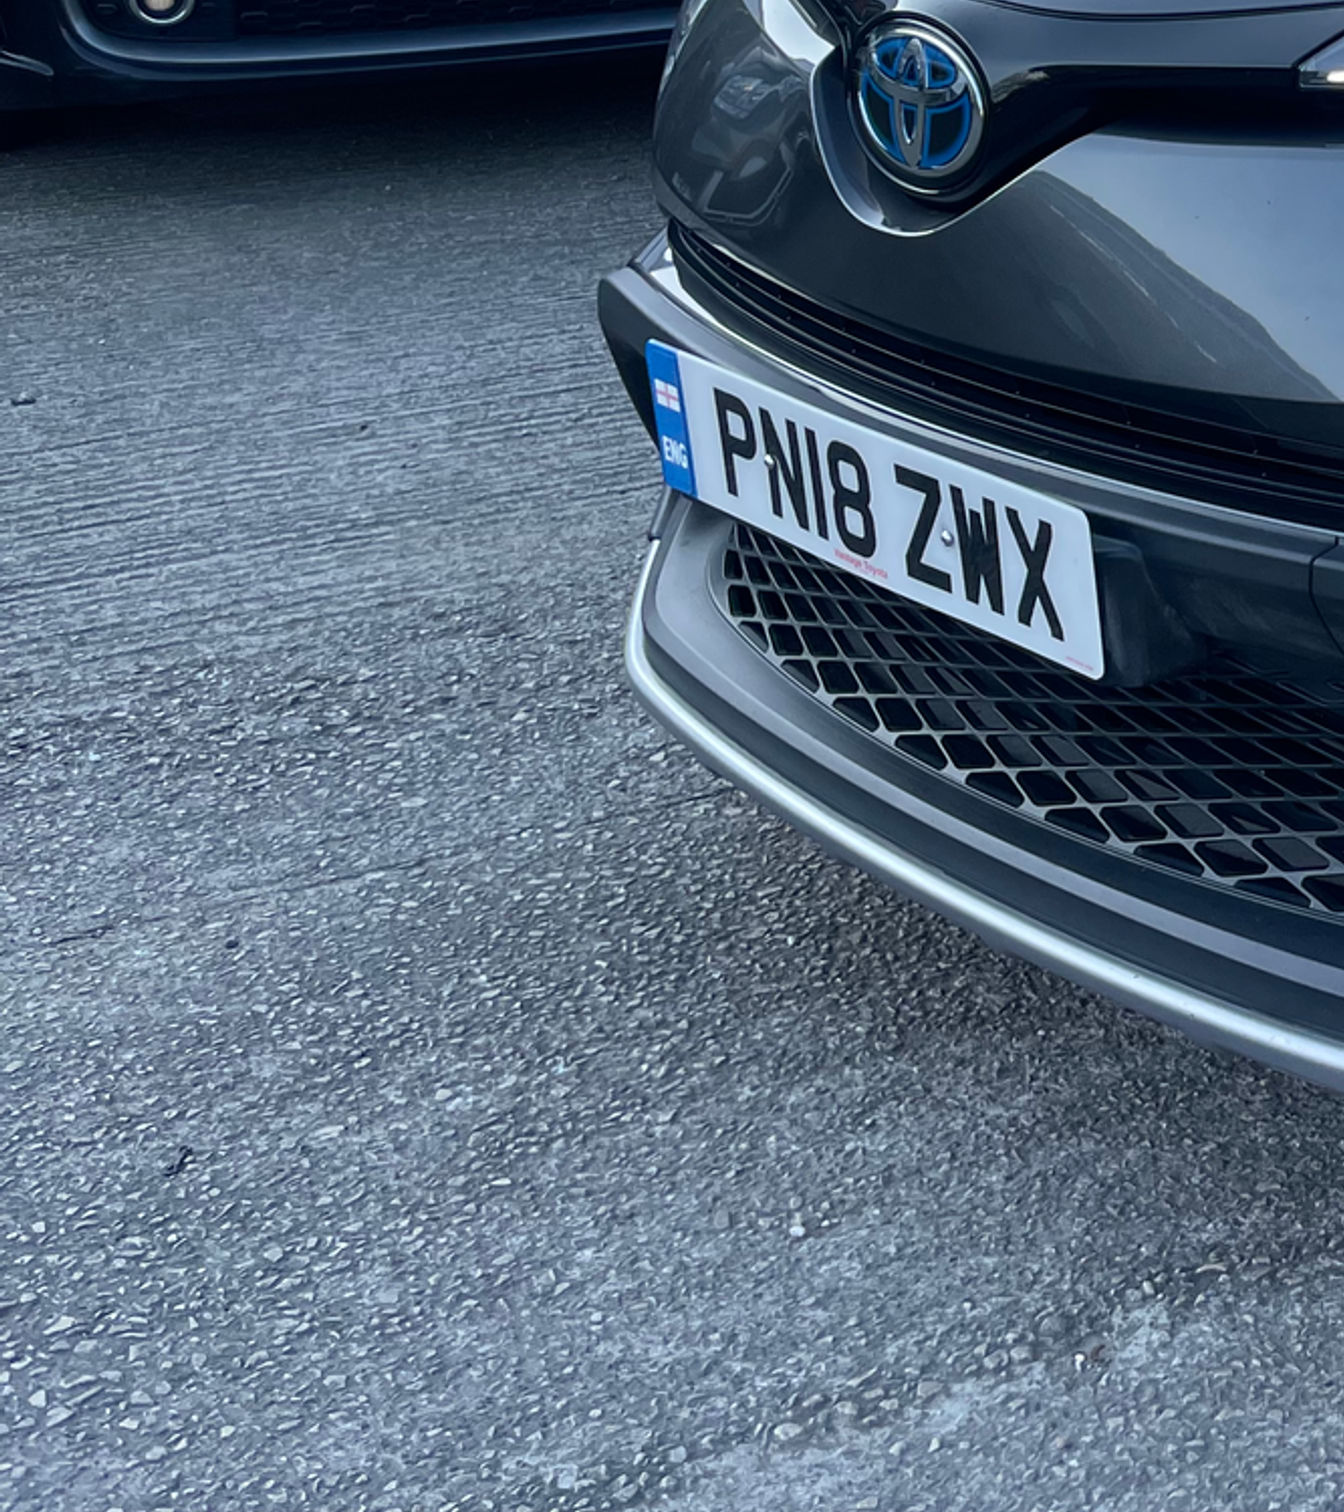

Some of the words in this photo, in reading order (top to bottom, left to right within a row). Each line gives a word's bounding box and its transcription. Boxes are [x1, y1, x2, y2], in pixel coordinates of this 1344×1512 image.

[661, 434, 689, 469] ENG
[713, 386, 878, 559] PN18
[893, 463, 1066, 643] ZWX
